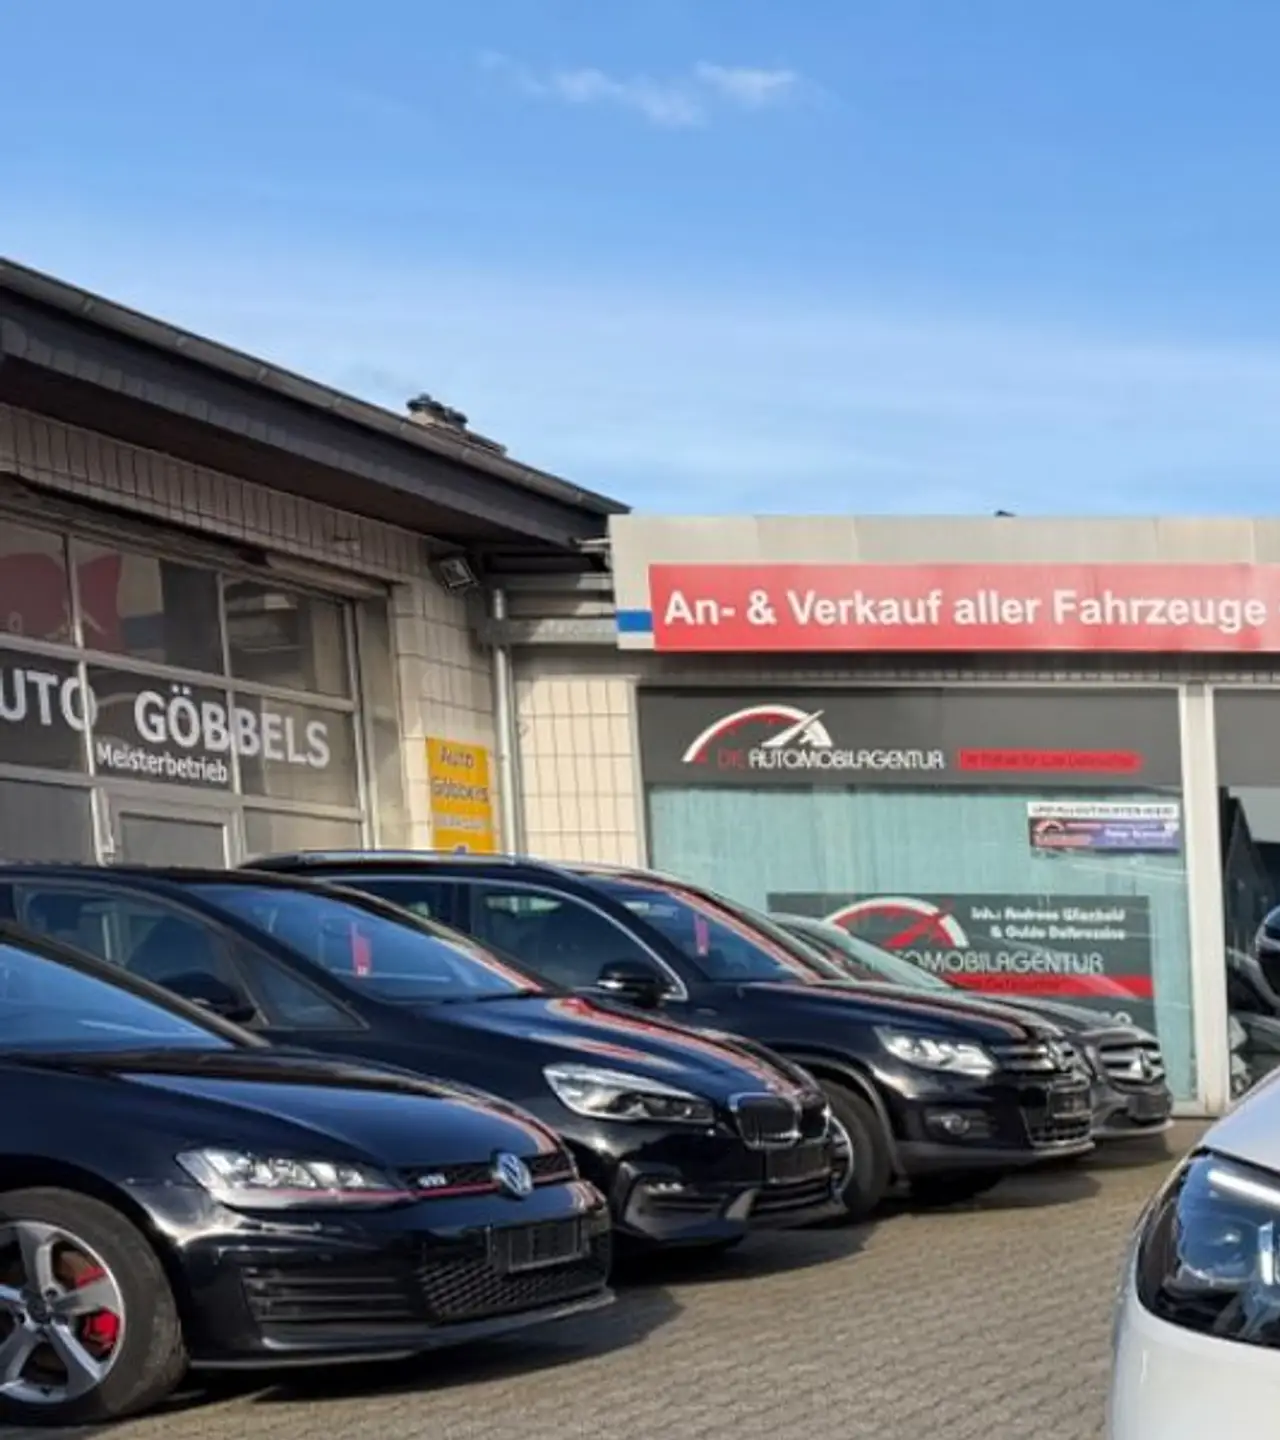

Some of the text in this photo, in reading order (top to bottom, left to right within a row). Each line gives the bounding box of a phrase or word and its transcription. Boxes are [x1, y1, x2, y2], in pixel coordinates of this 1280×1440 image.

[664, 589, 736, 626] An-
[746, 589, 778, 626] &
[786, 589, 943, 626] Verkauf
[952, 589, 1042, 626] aller
[1053, 589, 1267, 634] Fahrzeuge
[0, 667, 331, 769] UTO GÖBBELS
[96, 742, 228, 783] Meisterbetrieb
[750, 749, 945, 770] AUTOMOBILAGENTUR
